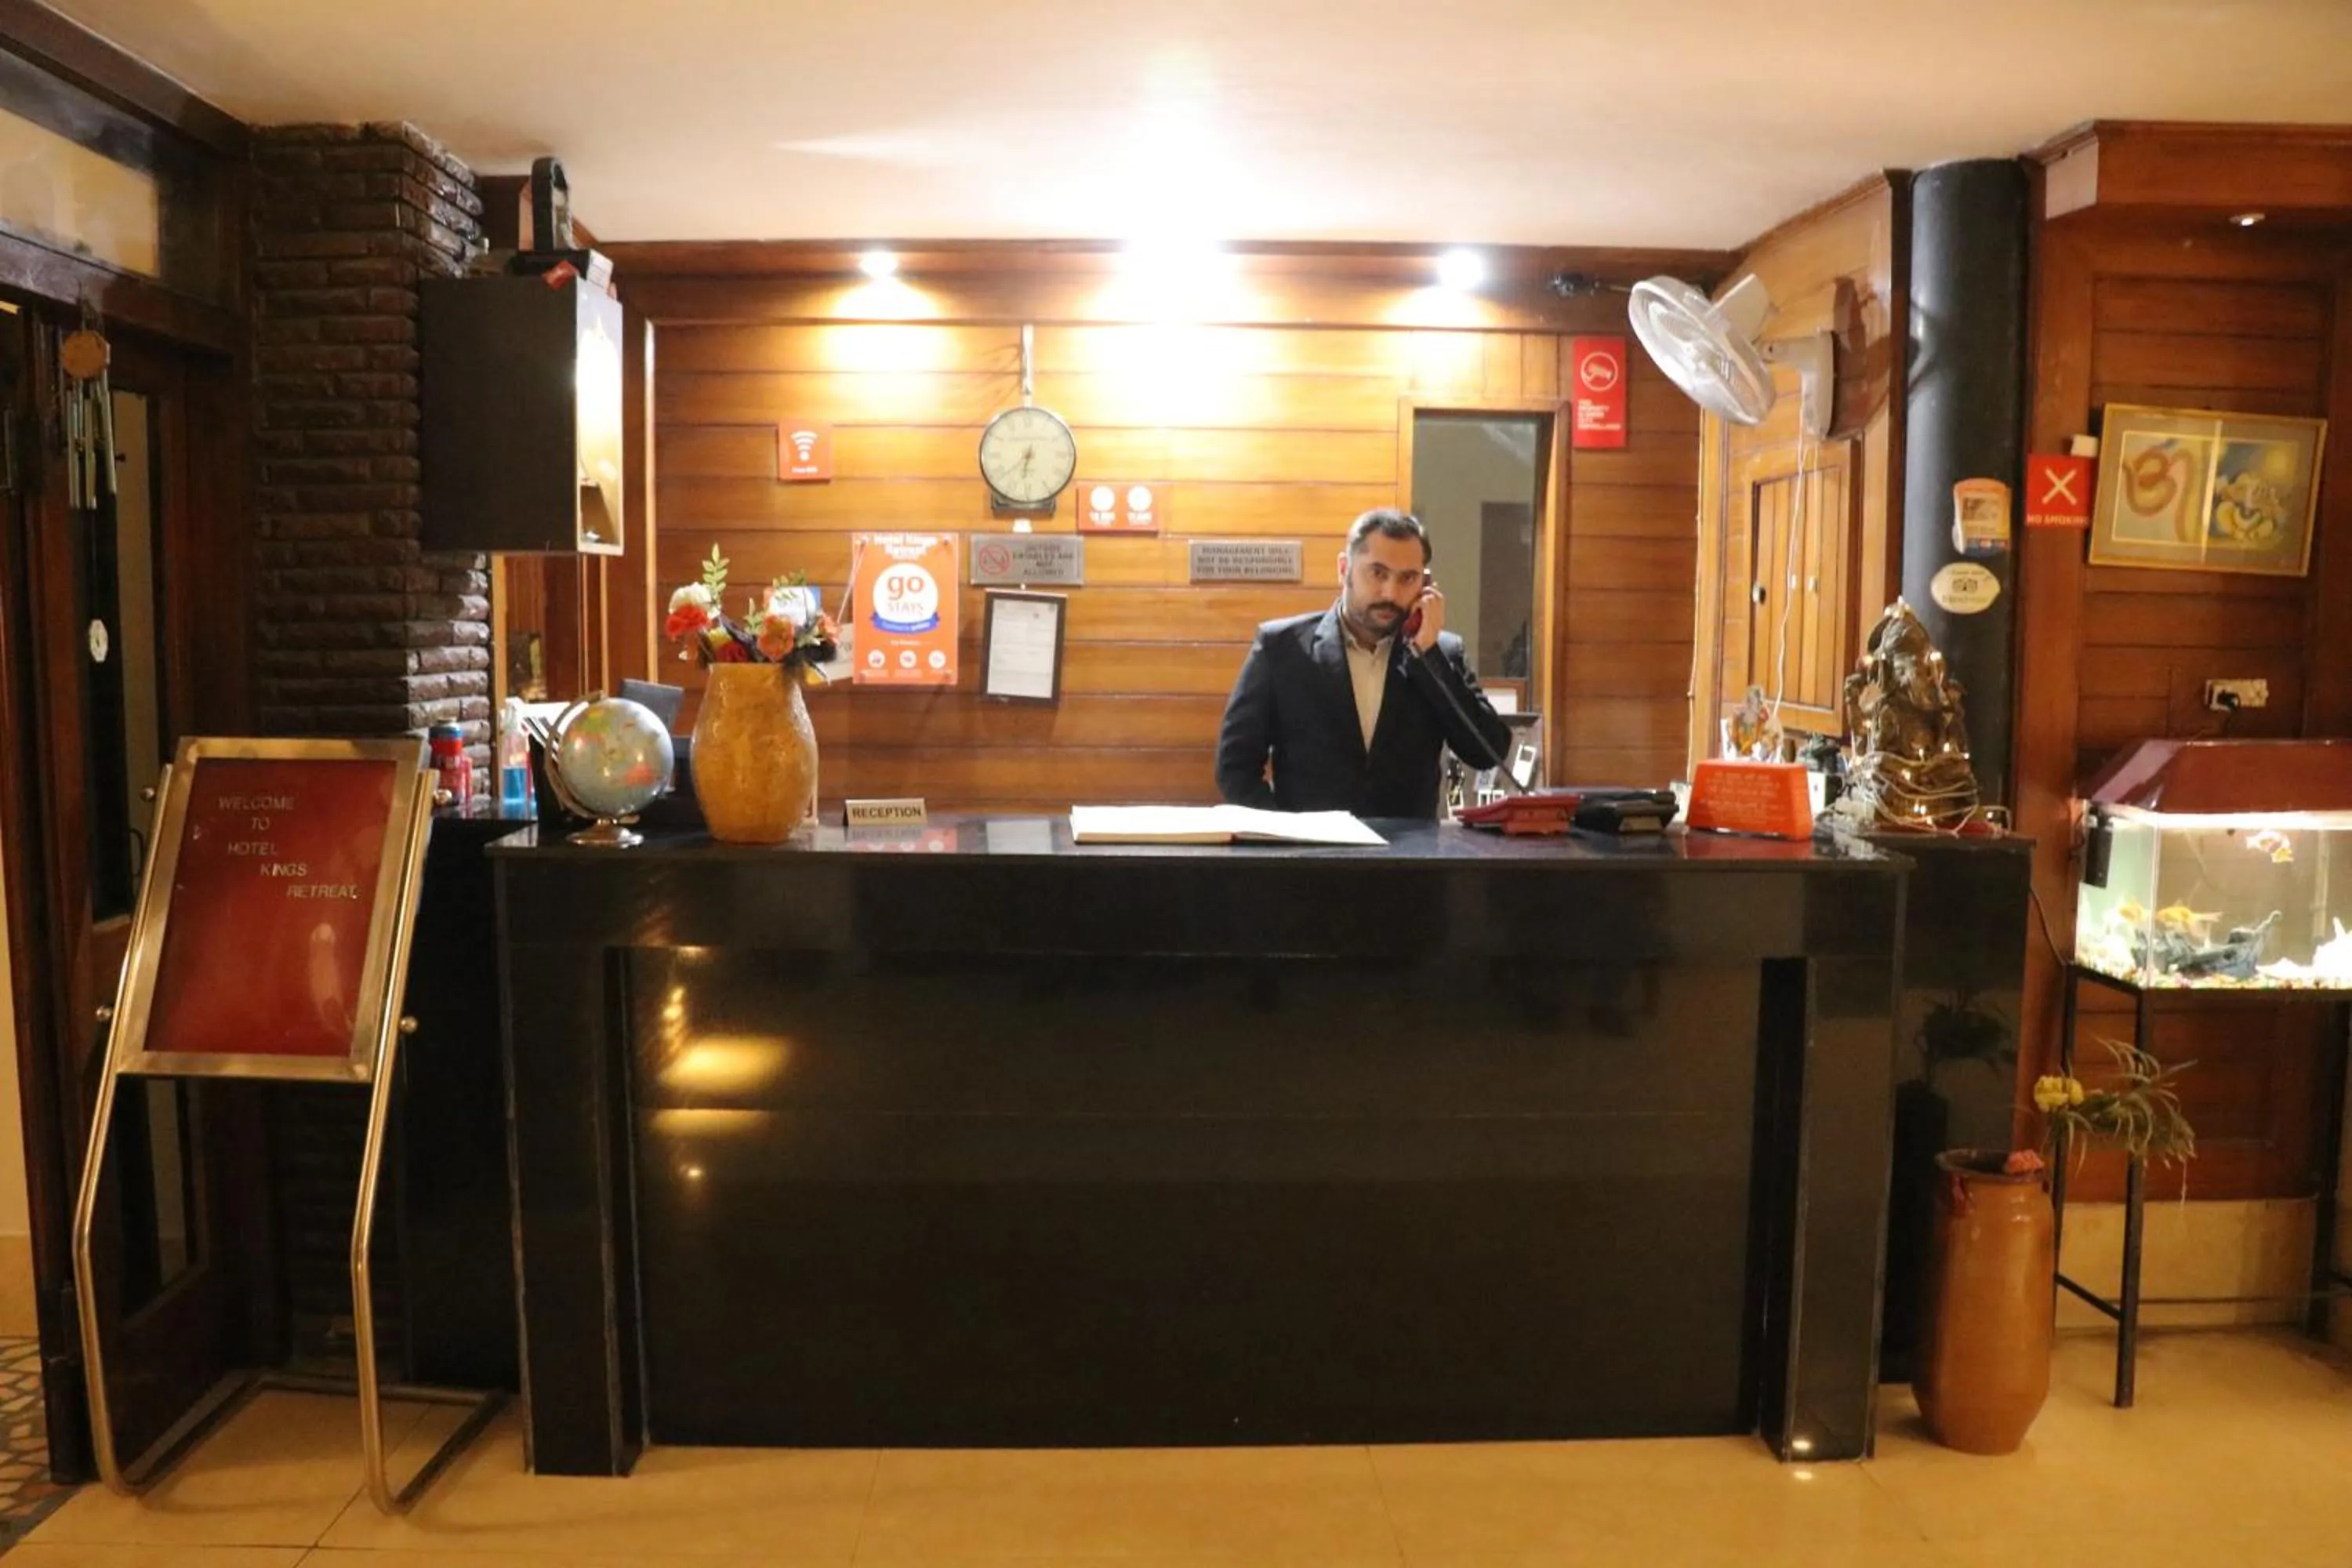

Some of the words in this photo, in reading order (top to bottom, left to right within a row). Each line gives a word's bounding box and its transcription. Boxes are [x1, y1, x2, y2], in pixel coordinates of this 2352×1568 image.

[2027, 514, 2042, 524] NO
[887, 575, 925, 601] go
[887, 601, 924, 612] STAYS
[218, 796, 294, 811] WELCOME
[851, 807, 921, 818] RECEPTION
[251, 816, 270, 831] TO
[227, 841, 278, 855] HOTEL
[260, 862, 307, 877] KINGS
[285, 884, 357, 898] RETREAT
